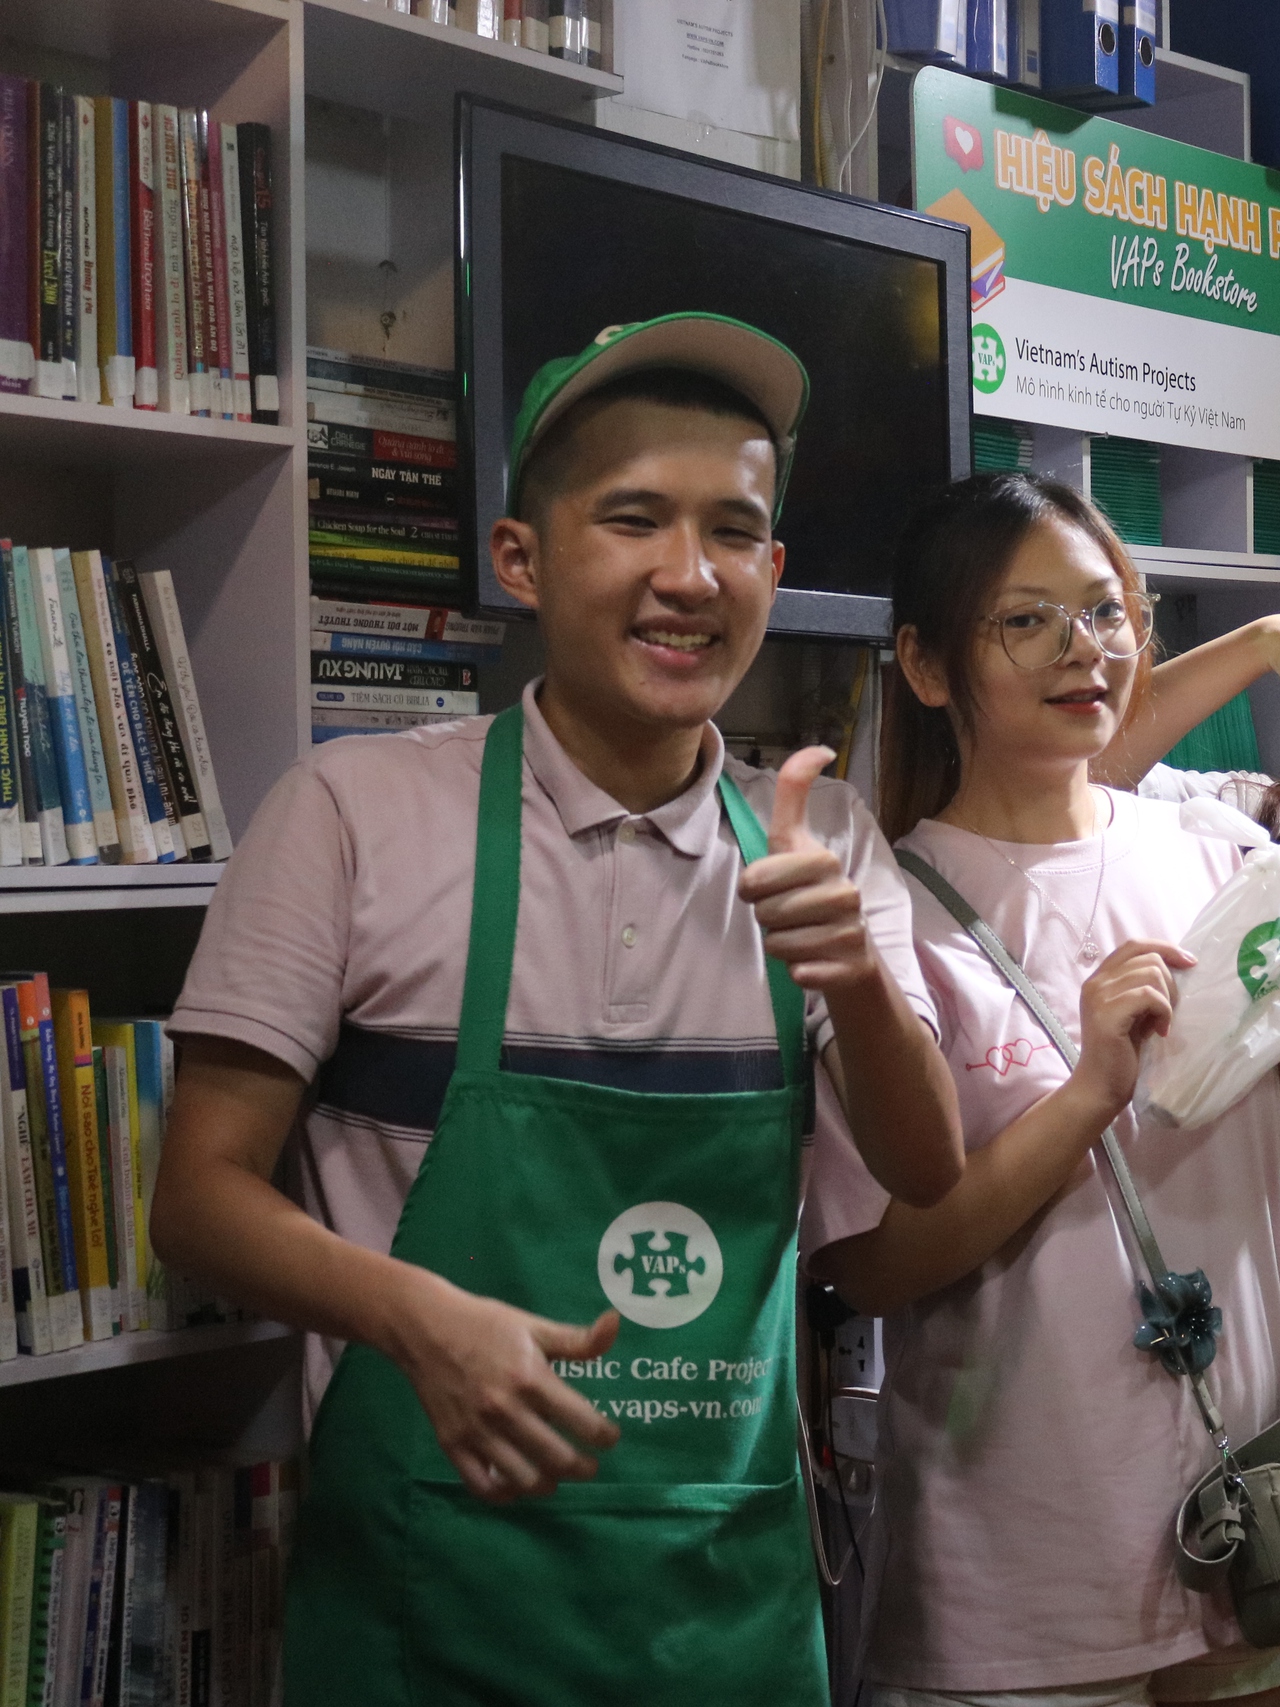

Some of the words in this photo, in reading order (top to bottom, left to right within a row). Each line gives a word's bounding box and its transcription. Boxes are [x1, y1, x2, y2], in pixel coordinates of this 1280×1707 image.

[994, 128, 1077, 213] HIỆU
[1082, 143, 1168, 232] SÁCH
[1175, 181, 1261, 254] HẠNH
[1110, 235, 1163, 290] VAPs
[1171, 242, 1258, 313] Bookstore
[1015, 337, 1086, 372] Vietnam's
[1090, 354, 1138, 382] Autism
[1142, 362, 1197, 392] Projects
[1016, 375, 1036, 396] Mô
[1039, 378, 1065, 401] hình
[1068, 382, 1092, 405] kinh
[1095, 385, 1107, 408] tế
[1109, 391, 1130, 412] cho
[1133, 399, 1165, 420] người
[1167, 401, 1182, 424] Tự
[1198, 407, 1219, 429] Việt
[1221, 411, 1246, 431] Nam
[128, 698, 142, 721] CHO
[641, 1255, 686, 1275] VAPs
[631, 1357, 698, 1380] Cafe
